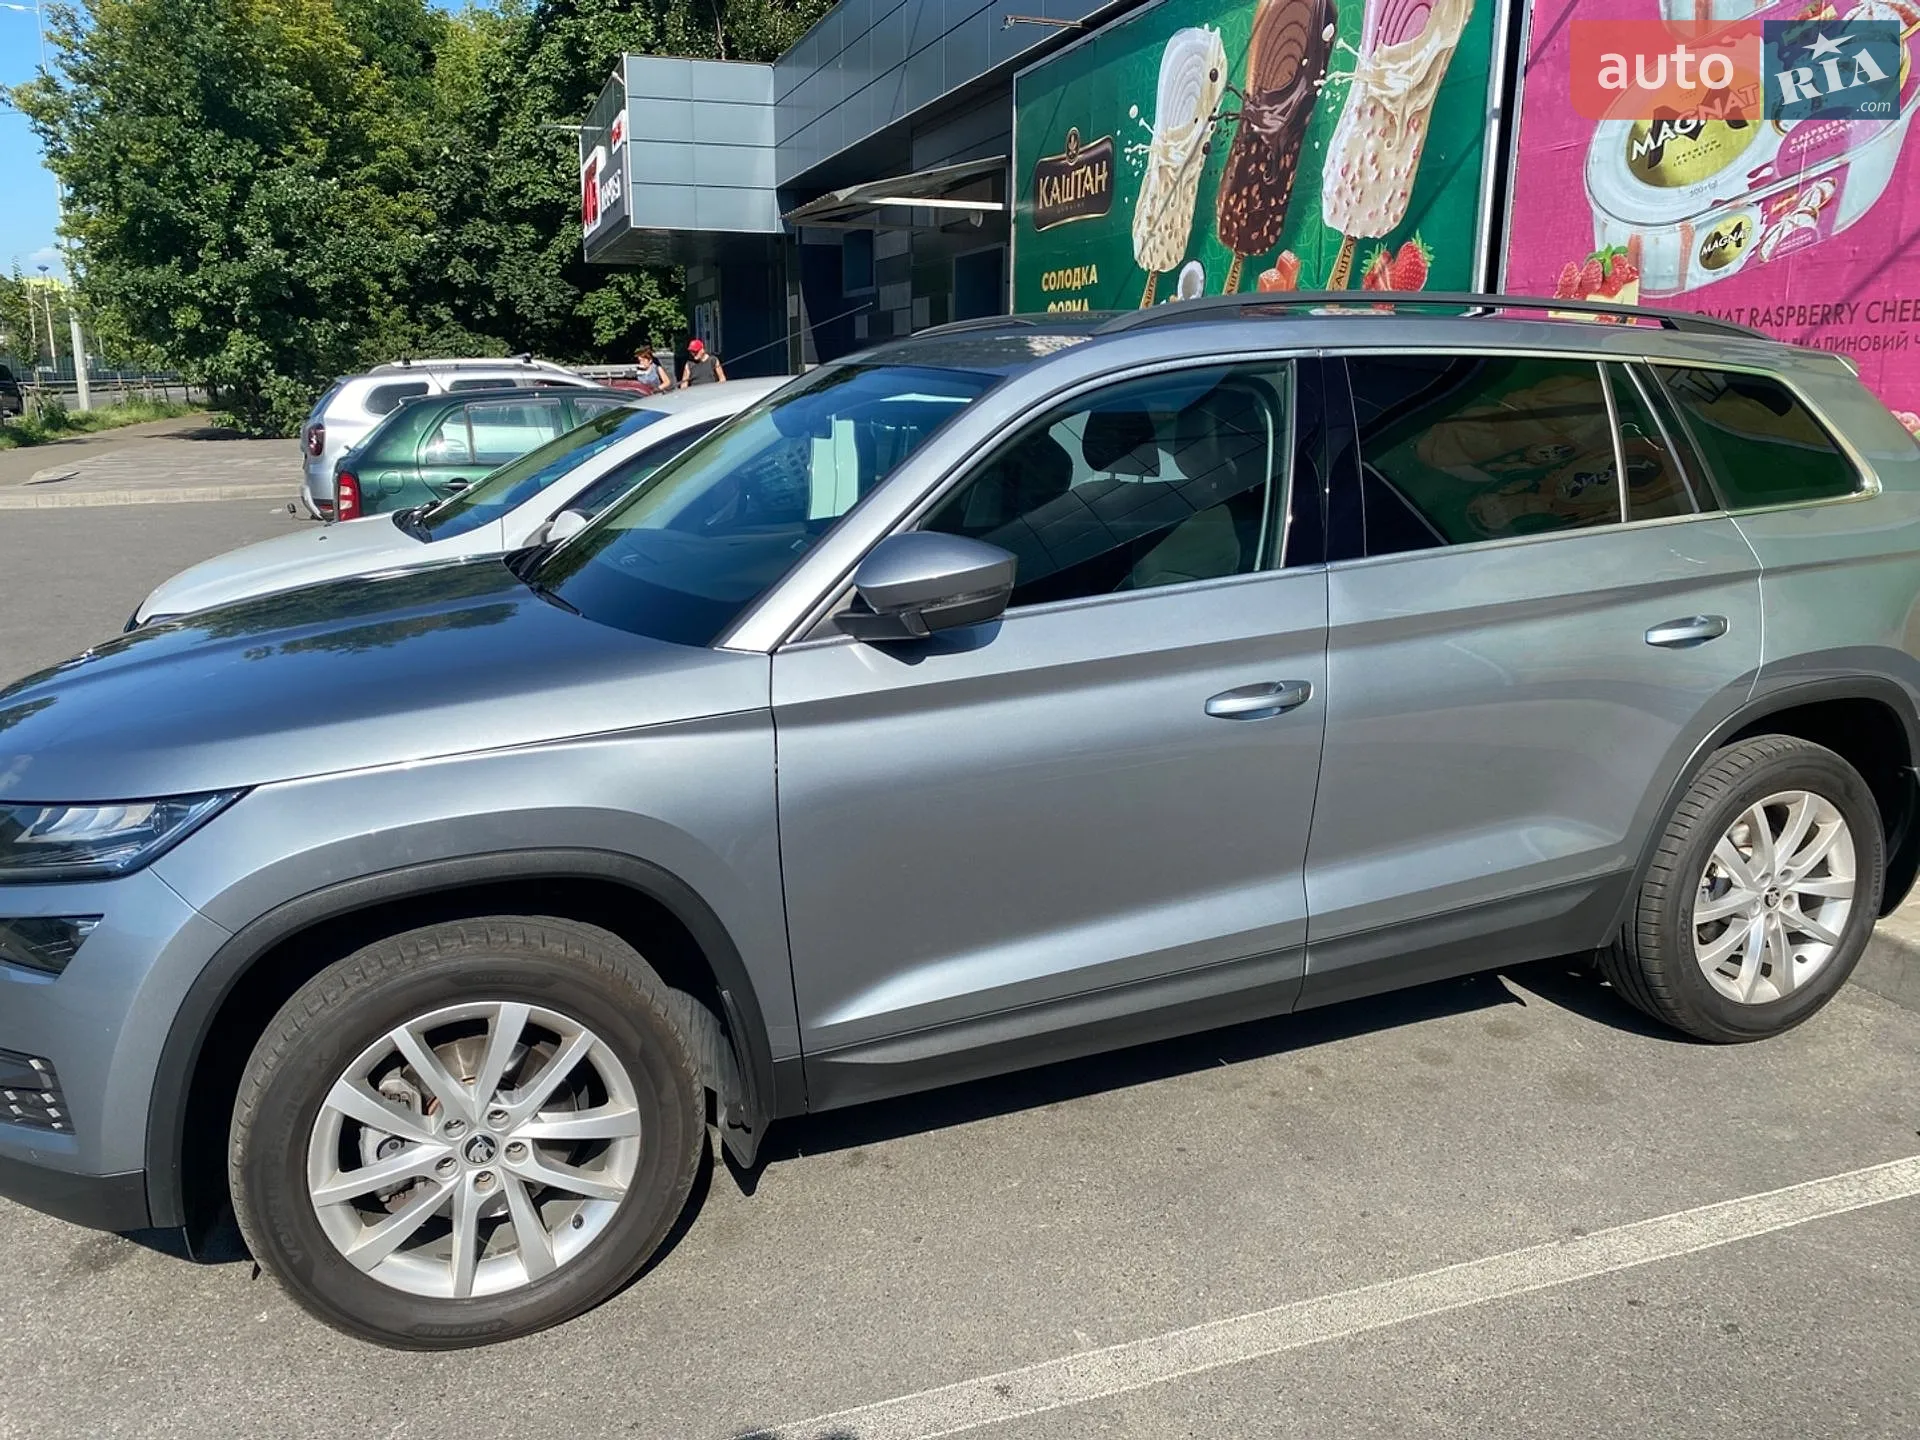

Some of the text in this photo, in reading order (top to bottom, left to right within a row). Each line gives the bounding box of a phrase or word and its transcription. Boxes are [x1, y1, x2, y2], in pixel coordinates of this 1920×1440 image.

[1790, 114, 1852, 145] RASPBERR
[1038, 160, 1109, 210] КАШТАН
[1041, 264, 1099, 292] СОЛОДКА
[1749, 302, 1861, 328] RASPBERRY
